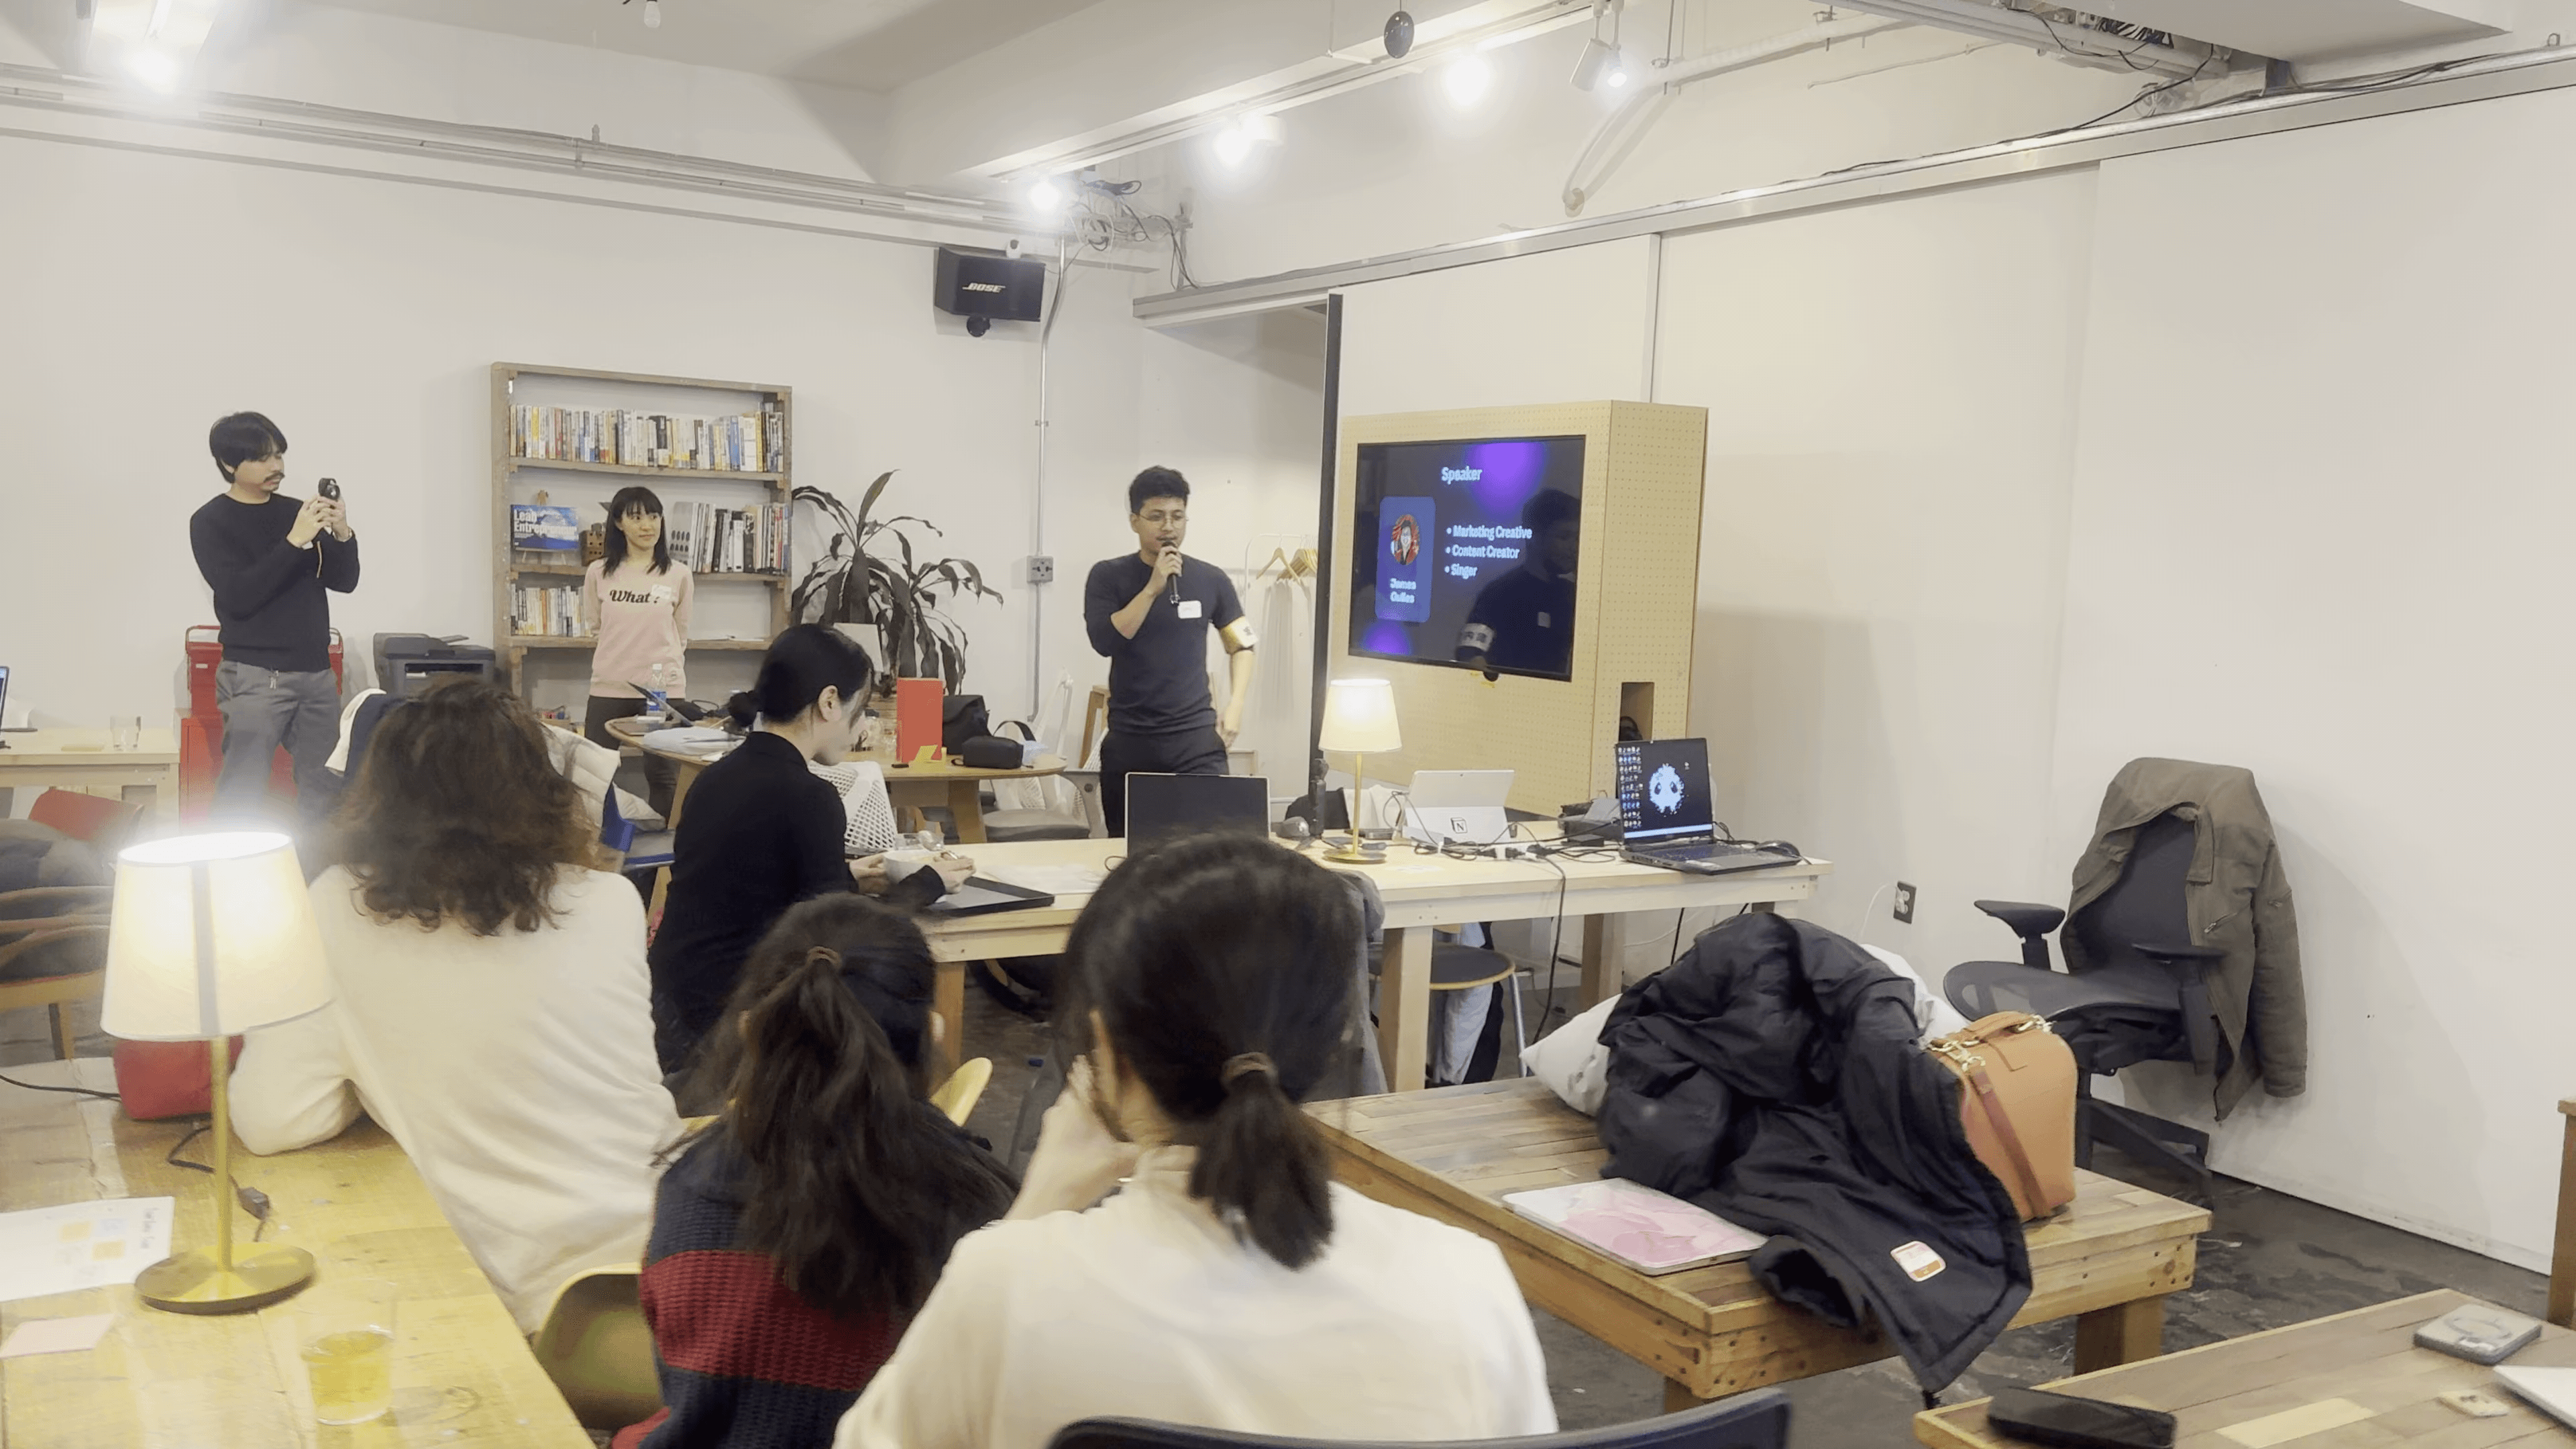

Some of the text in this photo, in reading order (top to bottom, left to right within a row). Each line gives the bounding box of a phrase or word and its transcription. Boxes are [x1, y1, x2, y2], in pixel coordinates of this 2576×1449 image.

[961, 282, 1006, 293] BOSE
[1442, 466, 1483, 484] Speaker
[1453, 525, 1533, 541] Marketing Creative
[1452, 544, 1520, 559] Content Creator
[1450, 564, 1478, 580] Singer
[610, 590, 651, 603] What
